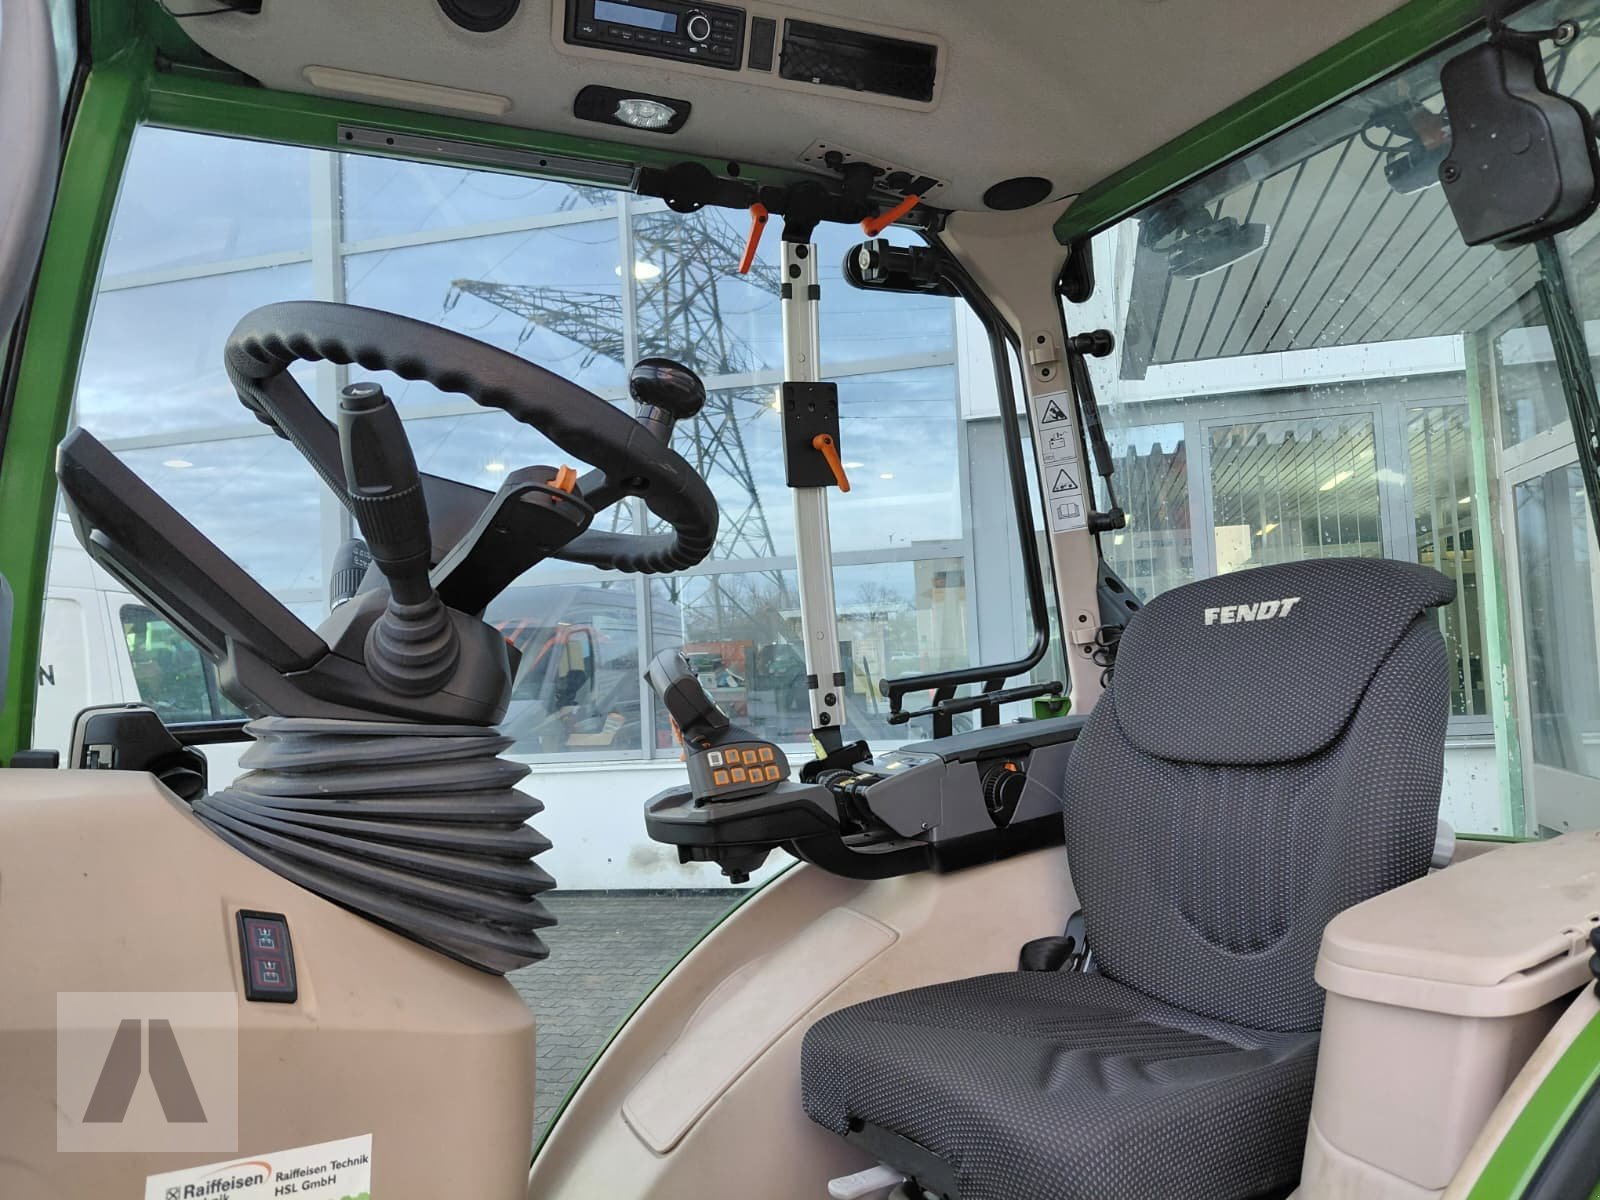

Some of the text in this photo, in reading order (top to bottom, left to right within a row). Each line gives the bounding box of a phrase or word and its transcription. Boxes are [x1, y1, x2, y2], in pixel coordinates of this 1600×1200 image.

[1204, 597, 1301, 626] FENDT
[275, 1154, 369, 1182] Raiffeisen Technik
[183, 1173, 263, 1199] Raiffeisen
[274, 1174, 337, 1197] HSL GmbH
